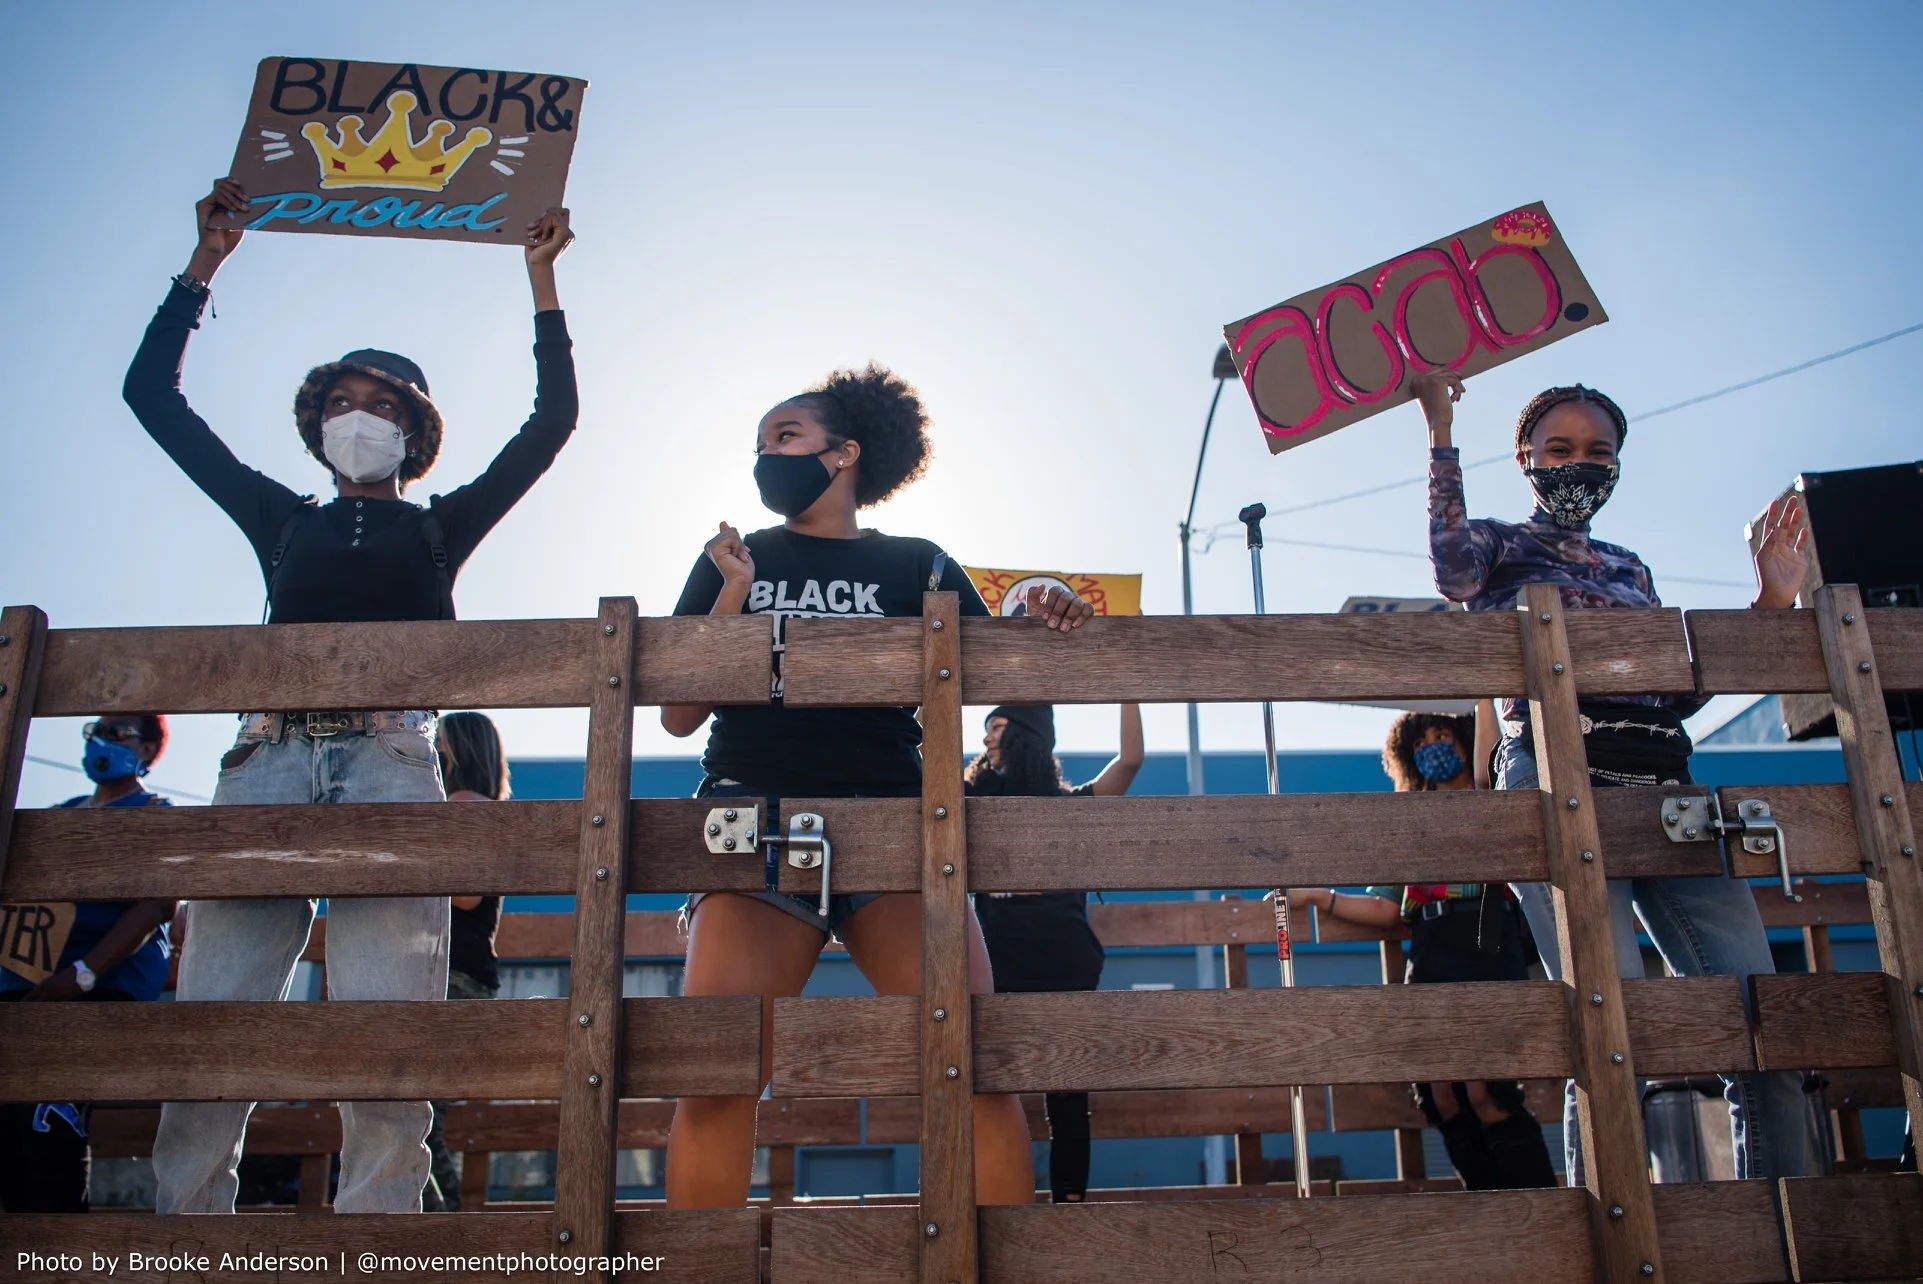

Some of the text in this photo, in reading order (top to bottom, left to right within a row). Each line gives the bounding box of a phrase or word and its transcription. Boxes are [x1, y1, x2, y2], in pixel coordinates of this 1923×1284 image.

[749, 579, 884, 614] BLACK
[1276, 905, 1290, 959] PROLINE
[1207, 1225, 1322, 1274] R 3
